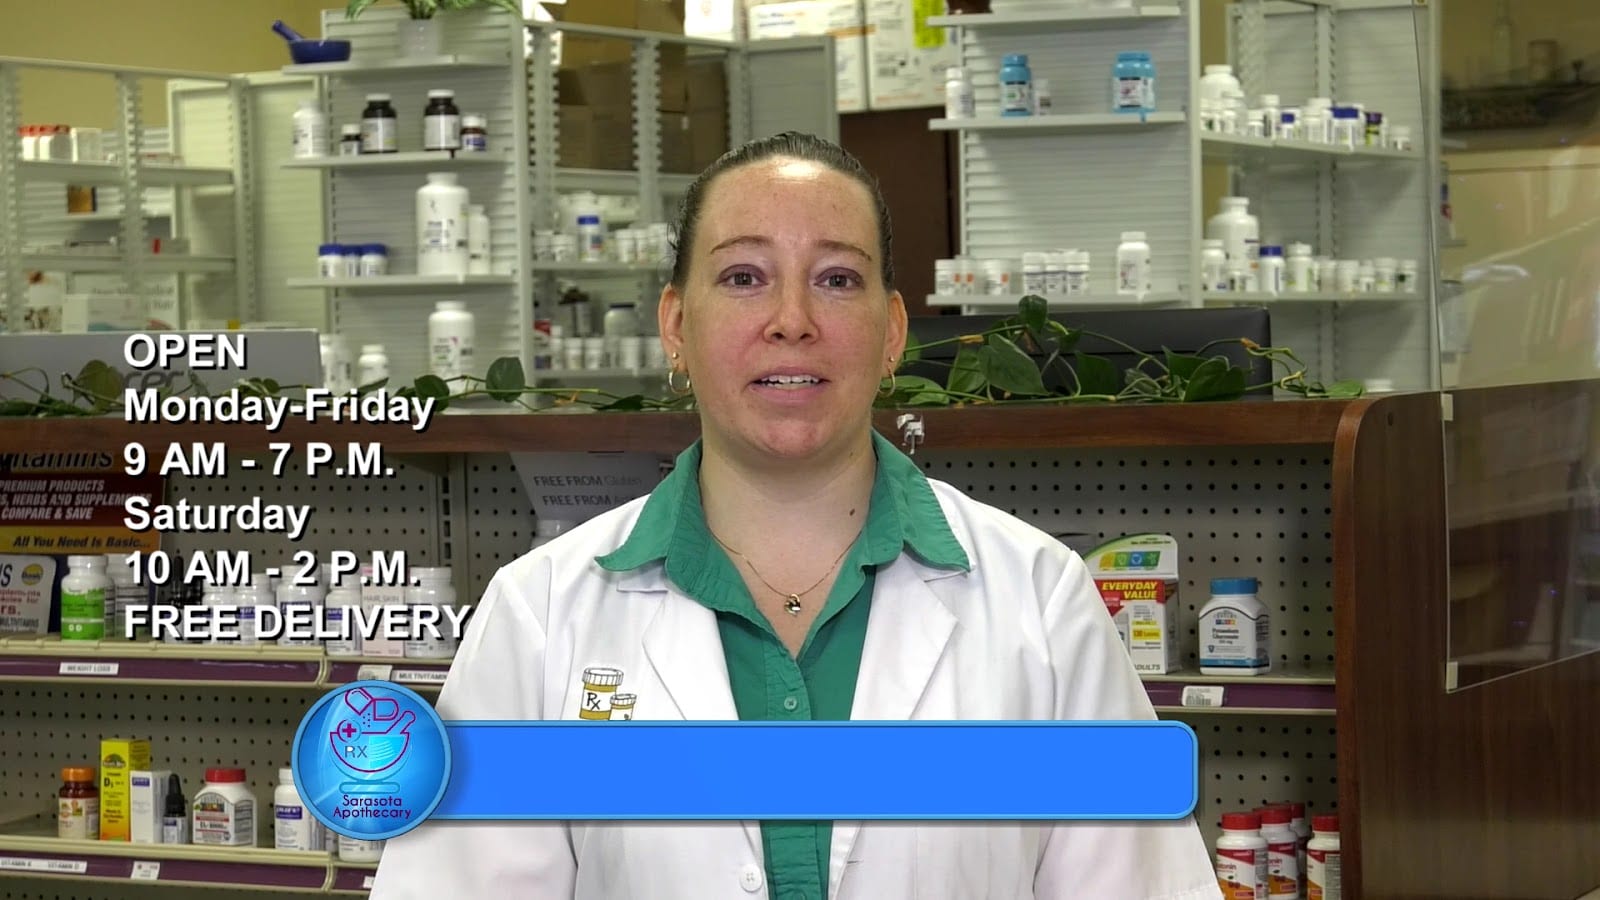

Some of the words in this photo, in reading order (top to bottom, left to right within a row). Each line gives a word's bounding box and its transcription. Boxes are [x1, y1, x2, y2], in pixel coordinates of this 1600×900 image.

[49, 480, 104, 492] PRODUCTS
[533, 476, 565, 486] FREE
[566, 476, 602, 486] FROM
[12, 494, 48, 505] HERBS
[542, 495, 573, 506] FREE
[573, 495, 613, 506] FROM
[1, 506, 52, 519] COMPARE
[53, 507, 63, 519] &
[65, 507, 94, 519] SAVE
[13, 536, 30, 547] All
[33, 536, 54, 547] You
[57, 536, 88, 548] Need
[90, 536, 101, 547] Is
[1102, 582, 1158, 591] EVERYDAY
[1123, 591, 1158, 599] VALUE
